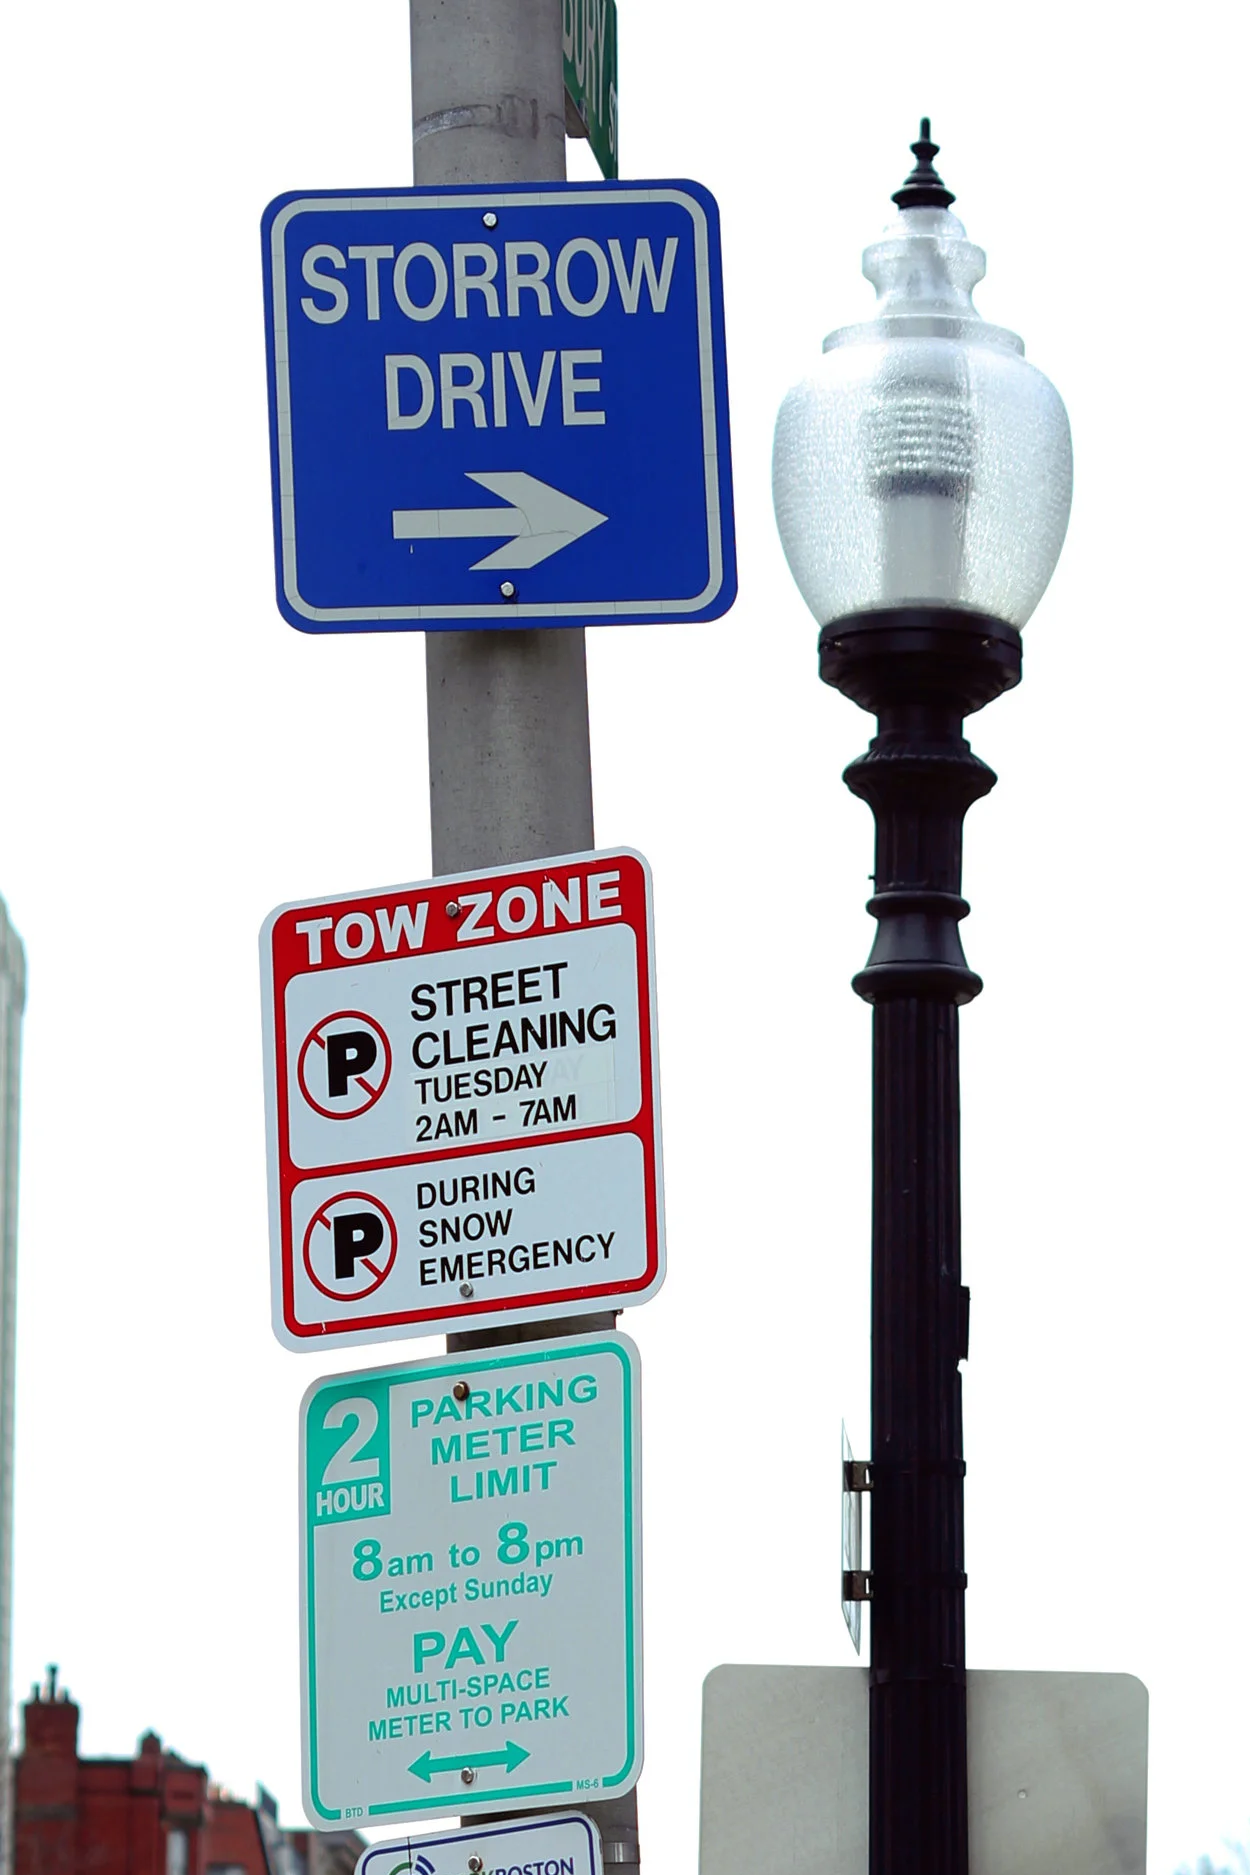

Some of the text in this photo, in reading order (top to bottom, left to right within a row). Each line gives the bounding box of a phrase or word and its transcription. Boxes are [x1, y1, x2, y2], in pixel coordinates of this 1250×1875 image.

[301, 237, 679, 325] STORROW
[385, 350, 606, 431] DRIVE
[296, 871, 622, 965] TOW ZONE
[411, 962, 568, 1022] STREET
[412, 1004, 616, 1070] CLEANING
[414, 1061, 548, 1105] TUESDAY
[415, 1108, 478, 1142] 2AM
[519, 1094, 576, 1127] 7AM
[417, 1167, 536, 1210] DURING
[419, 1209, 513, 1248] SNOW
[420, 1232, 616, 1287] EMERGENCY
[411, 1374, 598, 1428] PARKING
[321, 1396, 380, 1487] 2
[431, 1417, 576, 1465] METER
[316, 1482, 385, 1517] HOUR
[450, 1460, 557, 1503] LIMIT
[352, 1521, 584, 1581] 8am to 8pm
[380, 1571, 553, 1613] Except Sunday
[413, 1620, 519, 1673] PAY
[386, 1666, 551, 1708] MULTI-SPACE
[368, 1695, 570, 1741] METER TO PARK
[576, 1777, 600, 1791] MS-6
[345, 1806, 364, 1819] BTD
